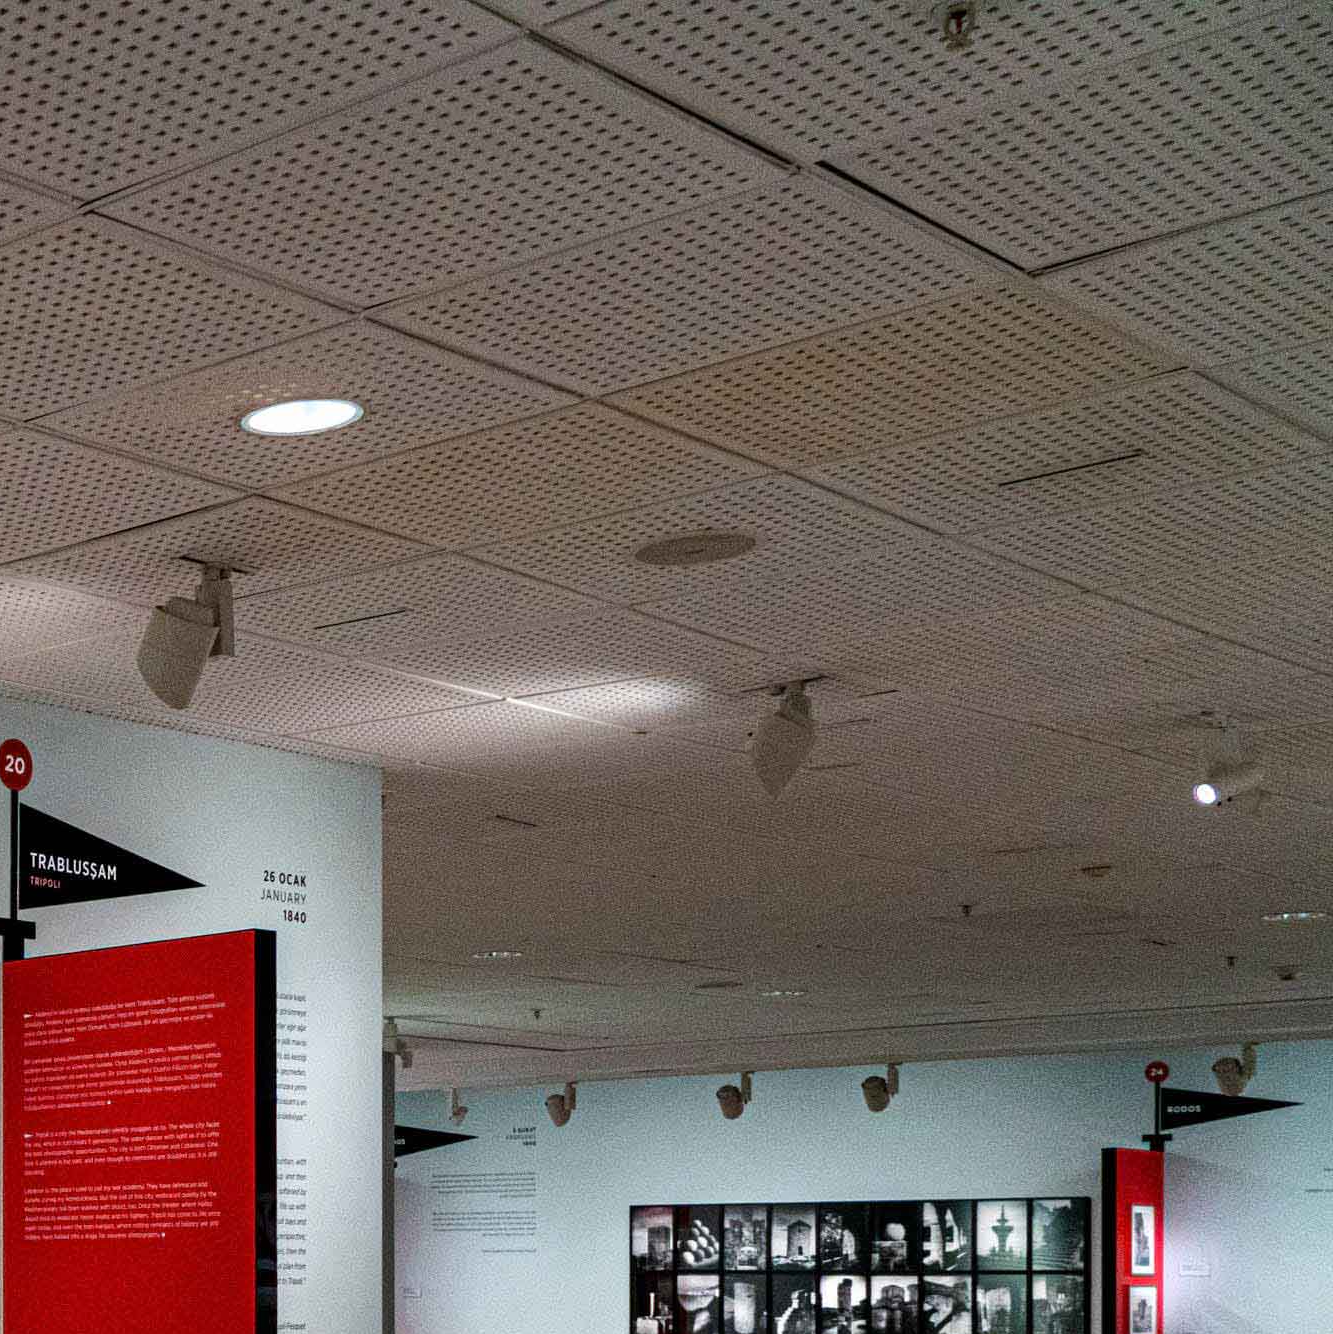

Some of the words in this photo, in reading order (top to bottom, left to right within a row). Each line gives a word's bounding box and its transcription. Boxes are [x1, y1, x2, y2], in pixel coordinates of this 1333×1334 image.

[4, 754, 25, 775] 20
[29, 852, 117, 882] TRABLUSŞAM
[30, 876, 61, 889] TRIPOLI
[263, 870, 276, 883] 26
[278, 872, 307, 888] OCAK
[260, 888, 307, 906] JANUARY
[282, 909, 307, 924] 1840
